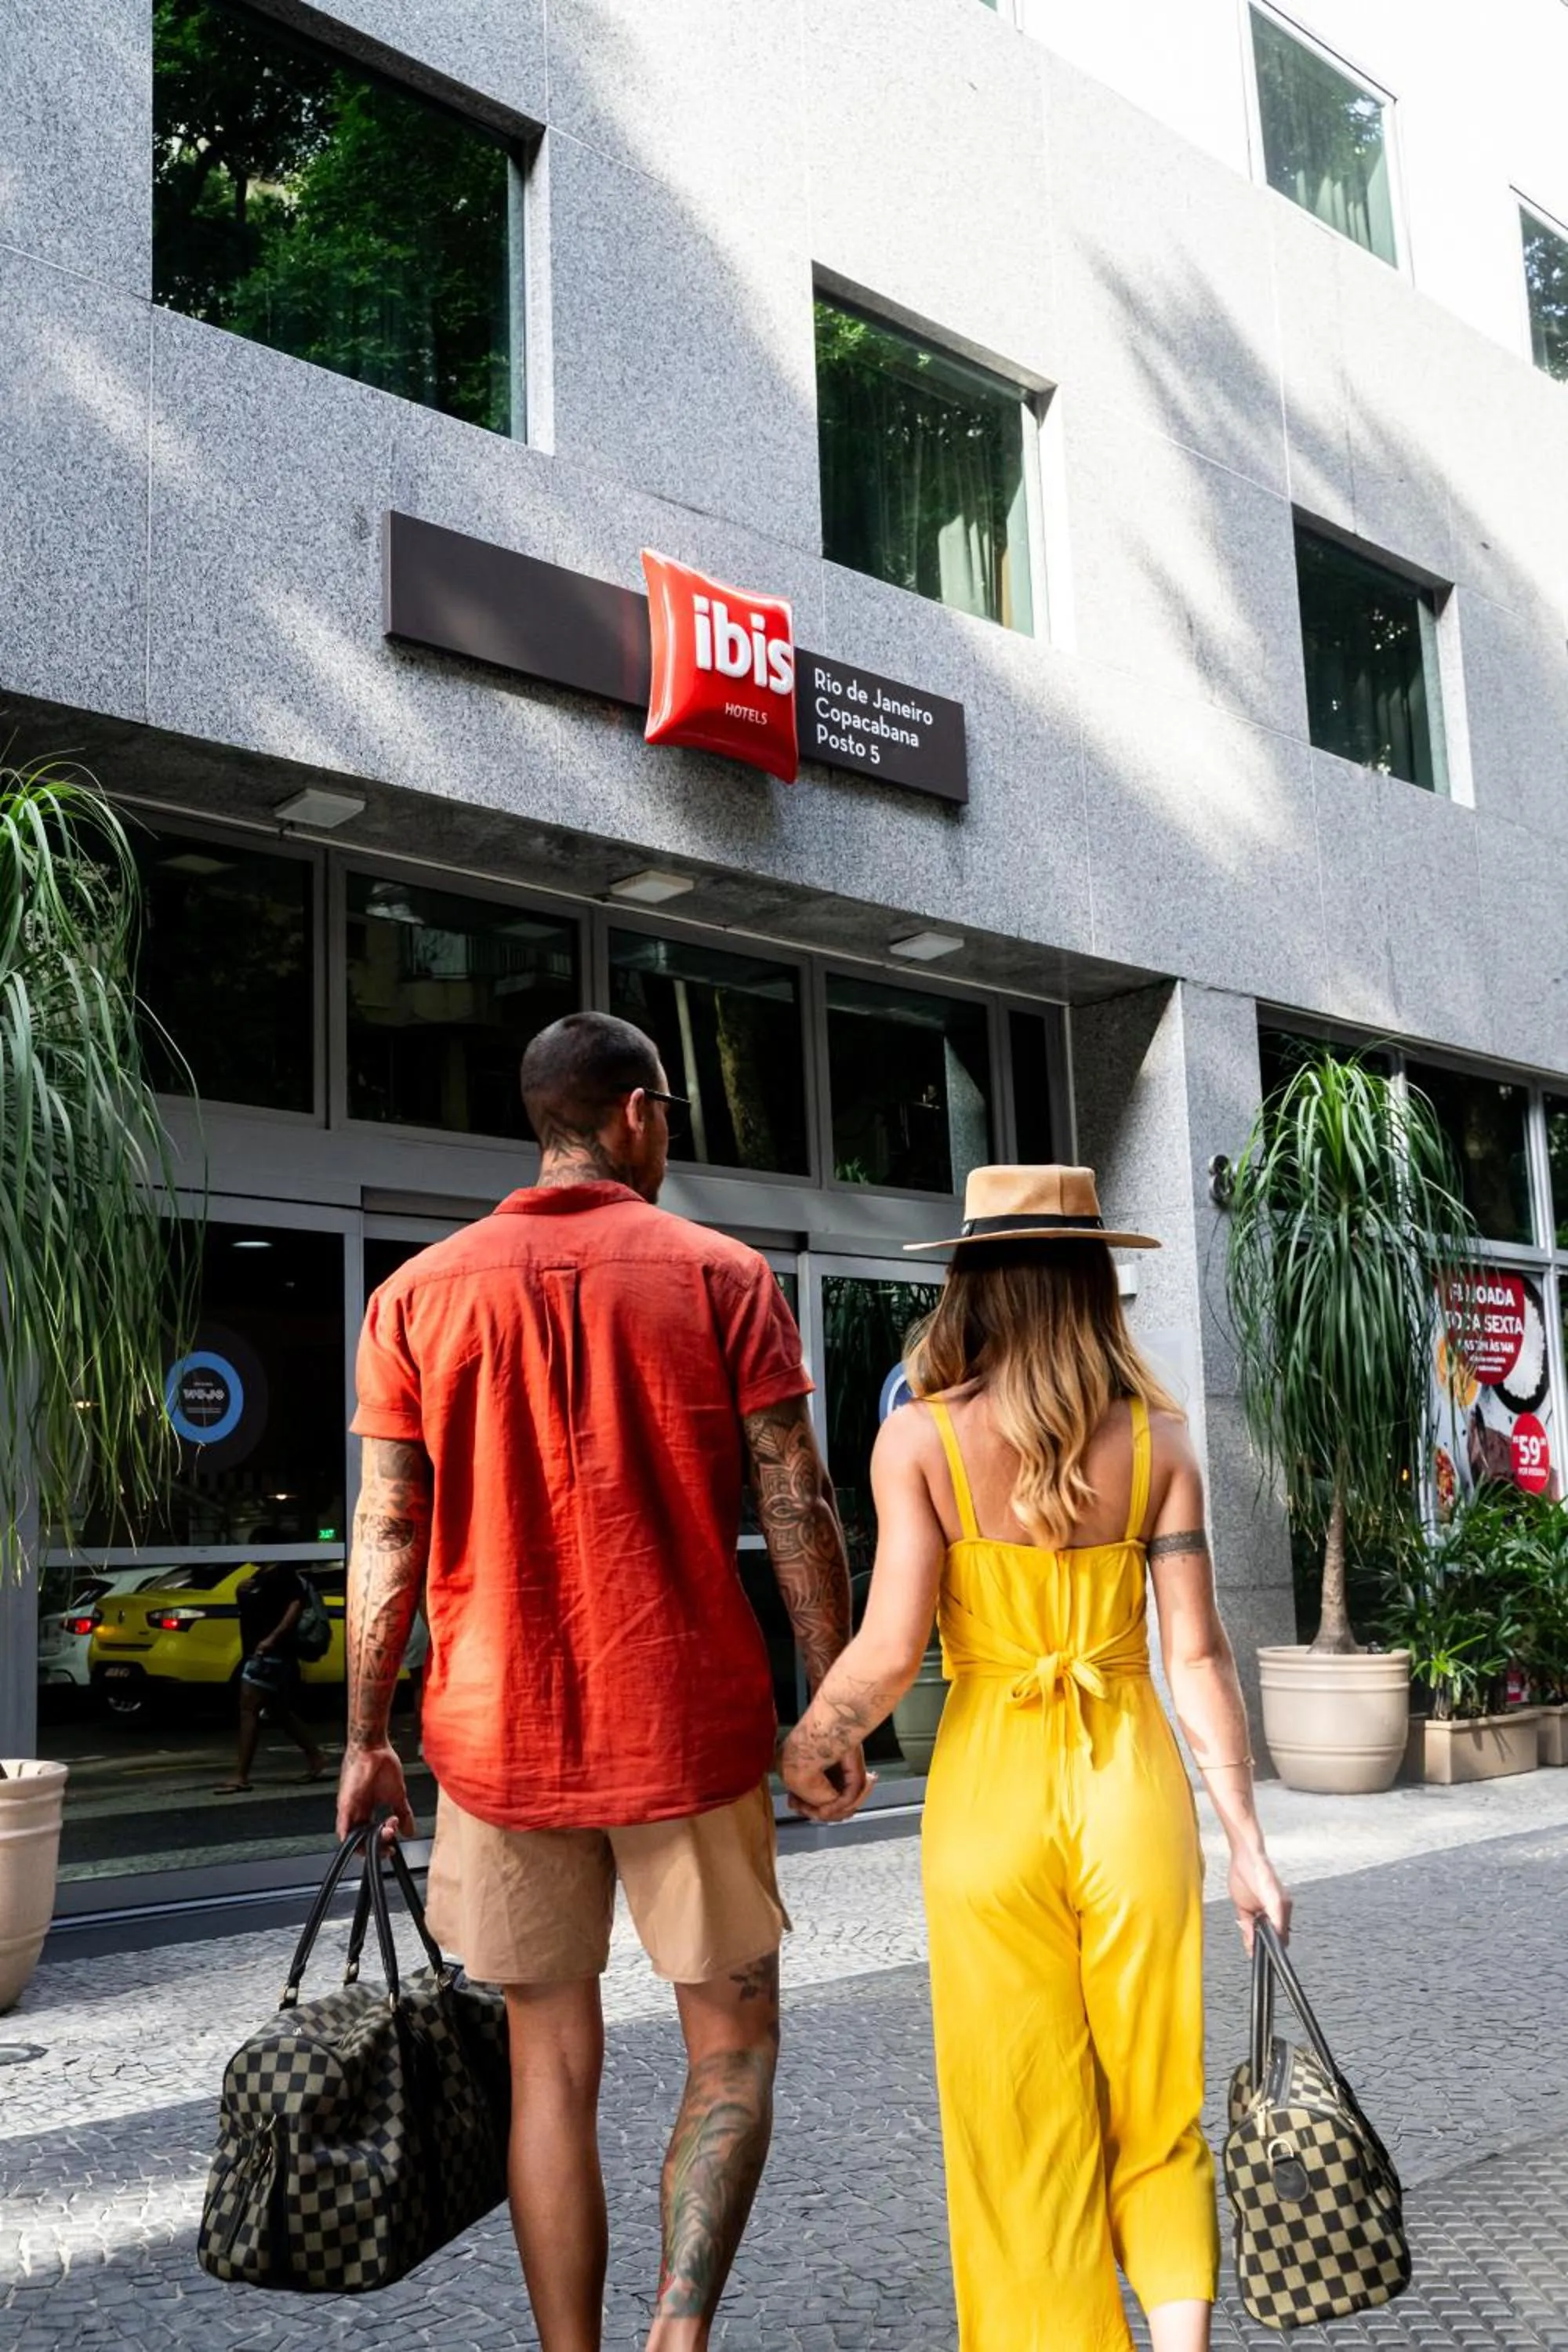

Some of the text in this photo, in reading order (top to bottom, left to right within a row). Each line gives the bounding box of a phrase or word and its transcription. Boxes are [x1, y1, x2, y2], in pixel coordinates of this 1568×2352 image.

[692, 593, 795, 695] ibis
[725, 702, 768, 725] HOTELS
[815, 667, 934, 725] Rio de Janeiro
[815, 697, 920, 747] Copacabana
[816, 723, 880, 764] Posto 5
[1484, 1314, 1524, 1336] SEXTA
[1519, 1435, 1541, 1465] 59
